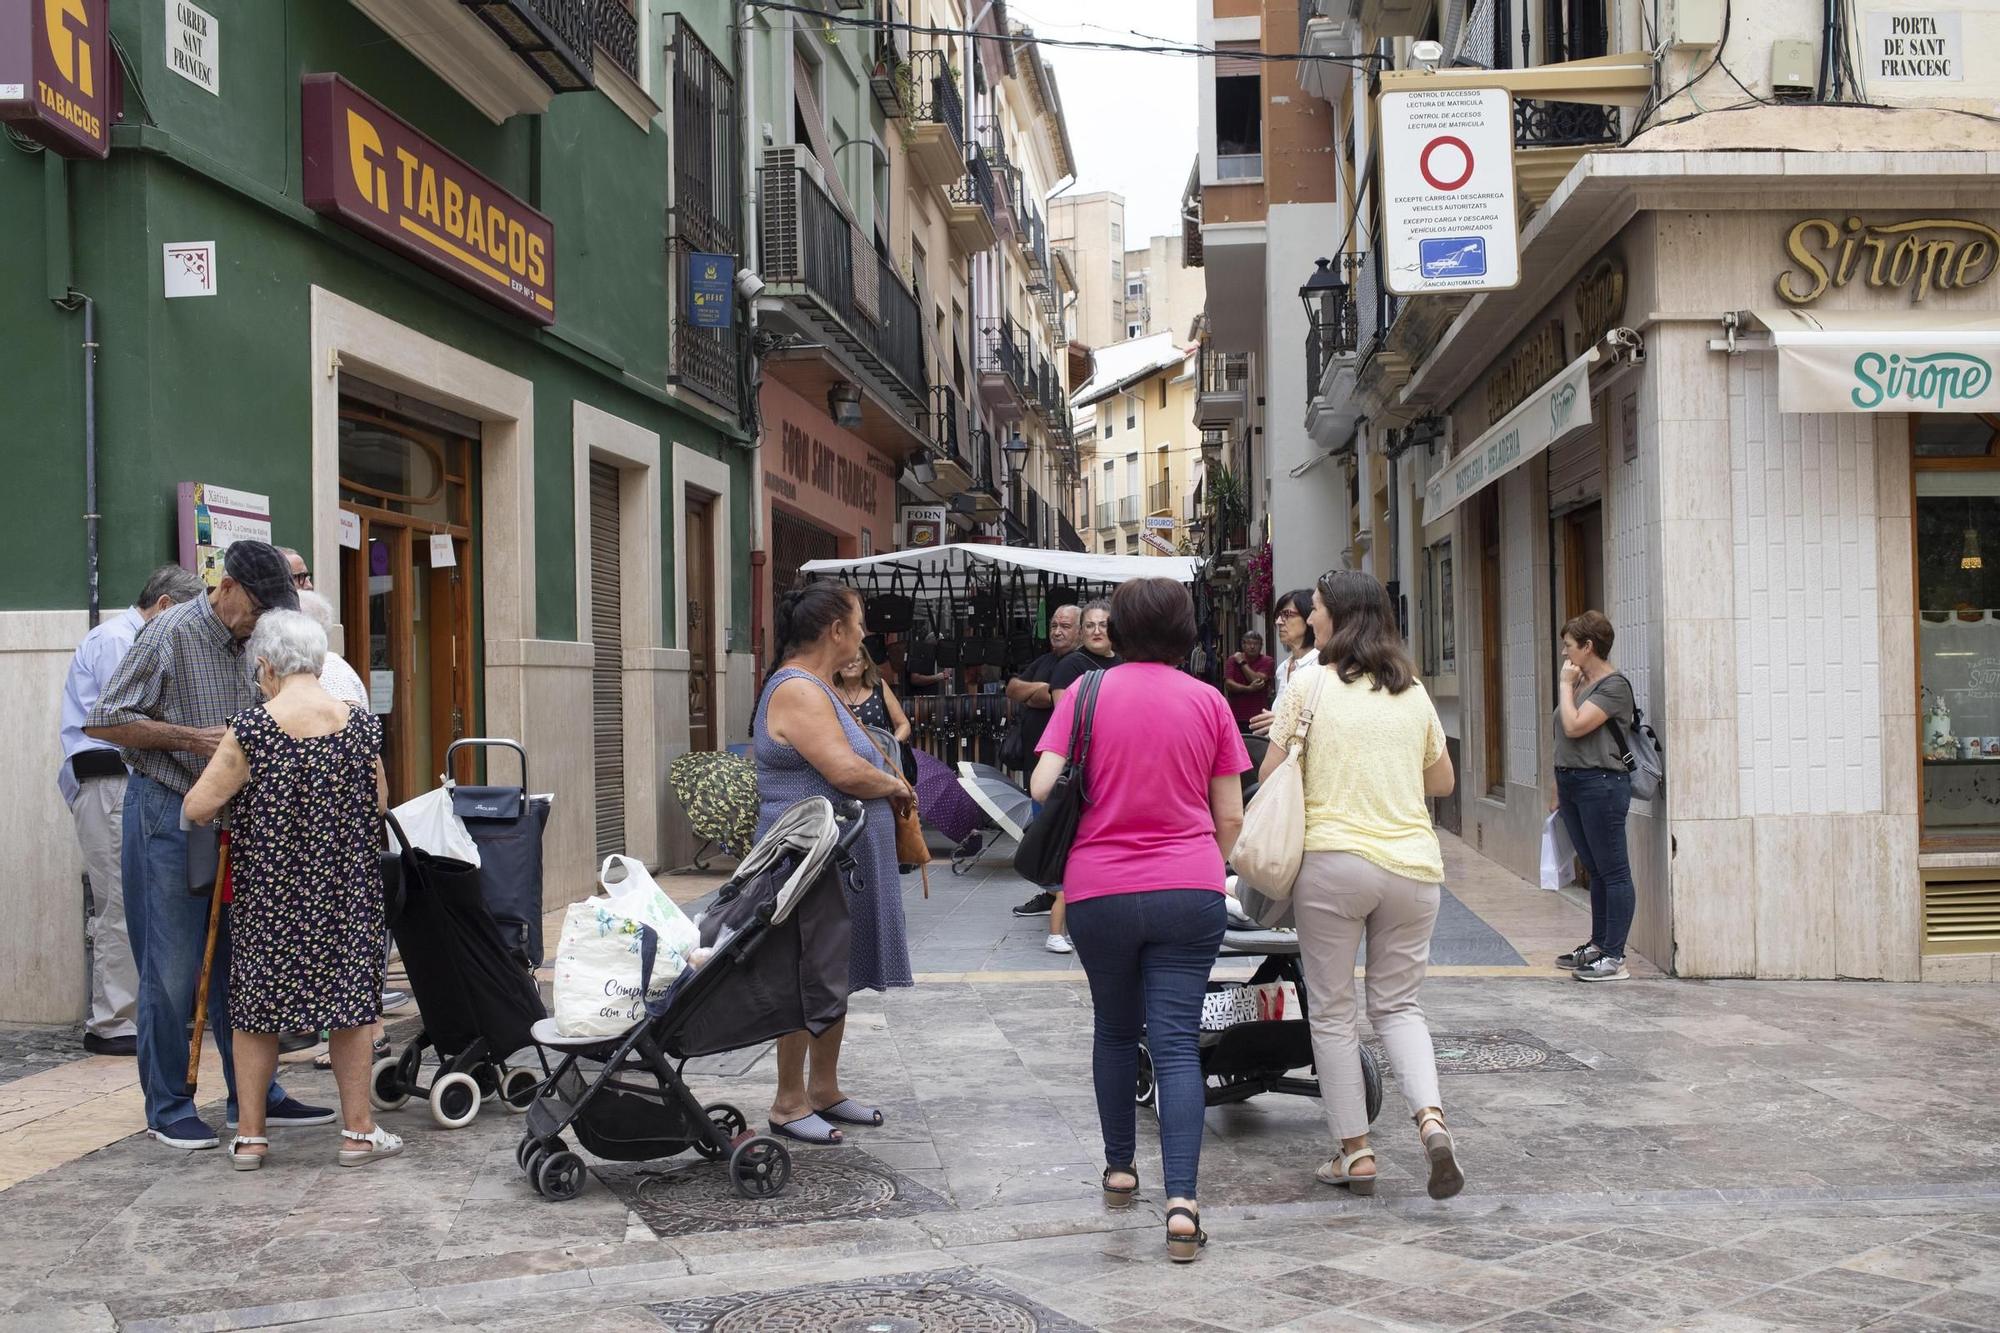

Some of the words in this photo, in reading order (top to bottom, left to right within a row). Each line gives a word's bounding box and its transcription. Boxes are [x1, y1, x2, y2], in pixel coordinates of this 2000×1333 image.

[178, 3, 207, 37] CARRER
[1892, 16, 1937, 35] PORTA
[183, 30, 202, 57] SANT
[1884, 38, 1904, 56] DE
[1909, 38, 1946, 56] SANT
[173, 46, 213, 86] FRANCESC
[1881, 59, 1951, 77] FRANCESC
[1440, 90, 1481, 98] D'ACCESSOS
[38, 79, 100, 139] TABACOS
[1451, 111, 1482, 119] ACCESOS
[1394, 196, 1424, 204] EXCEPTE
[1412, 204, 1444, 212] VEHICLES
[1444, 202, 1487, 211] AUTORITZATS
[396, 146, 546, 287] TABACOS
[1403, 217, 1433, 225] EXCEPTO
[1434, 215, 1457, 224] CARGA
[1463, 214, 1499, 223] DESCARGA
[1447, 224, 1493, 233] AUTORIZADOS
[1774, 215, 2000, 304] Sirope
[1851, 351, 1993, 409] Sirope
[782, 419, 810, 485] FORN
[812, 438, 836, 497] SANT
[1455, 455, 1484, 498] PASTELERIA
[1487, 427, 1521, 476] HELADERIA
[907, 511, 942, 520] FORN
[1147, 519, 1174, 527] SEGUROS
[600, 1007, 621, 1018] con
[627, 1001, 640, 1021] el
